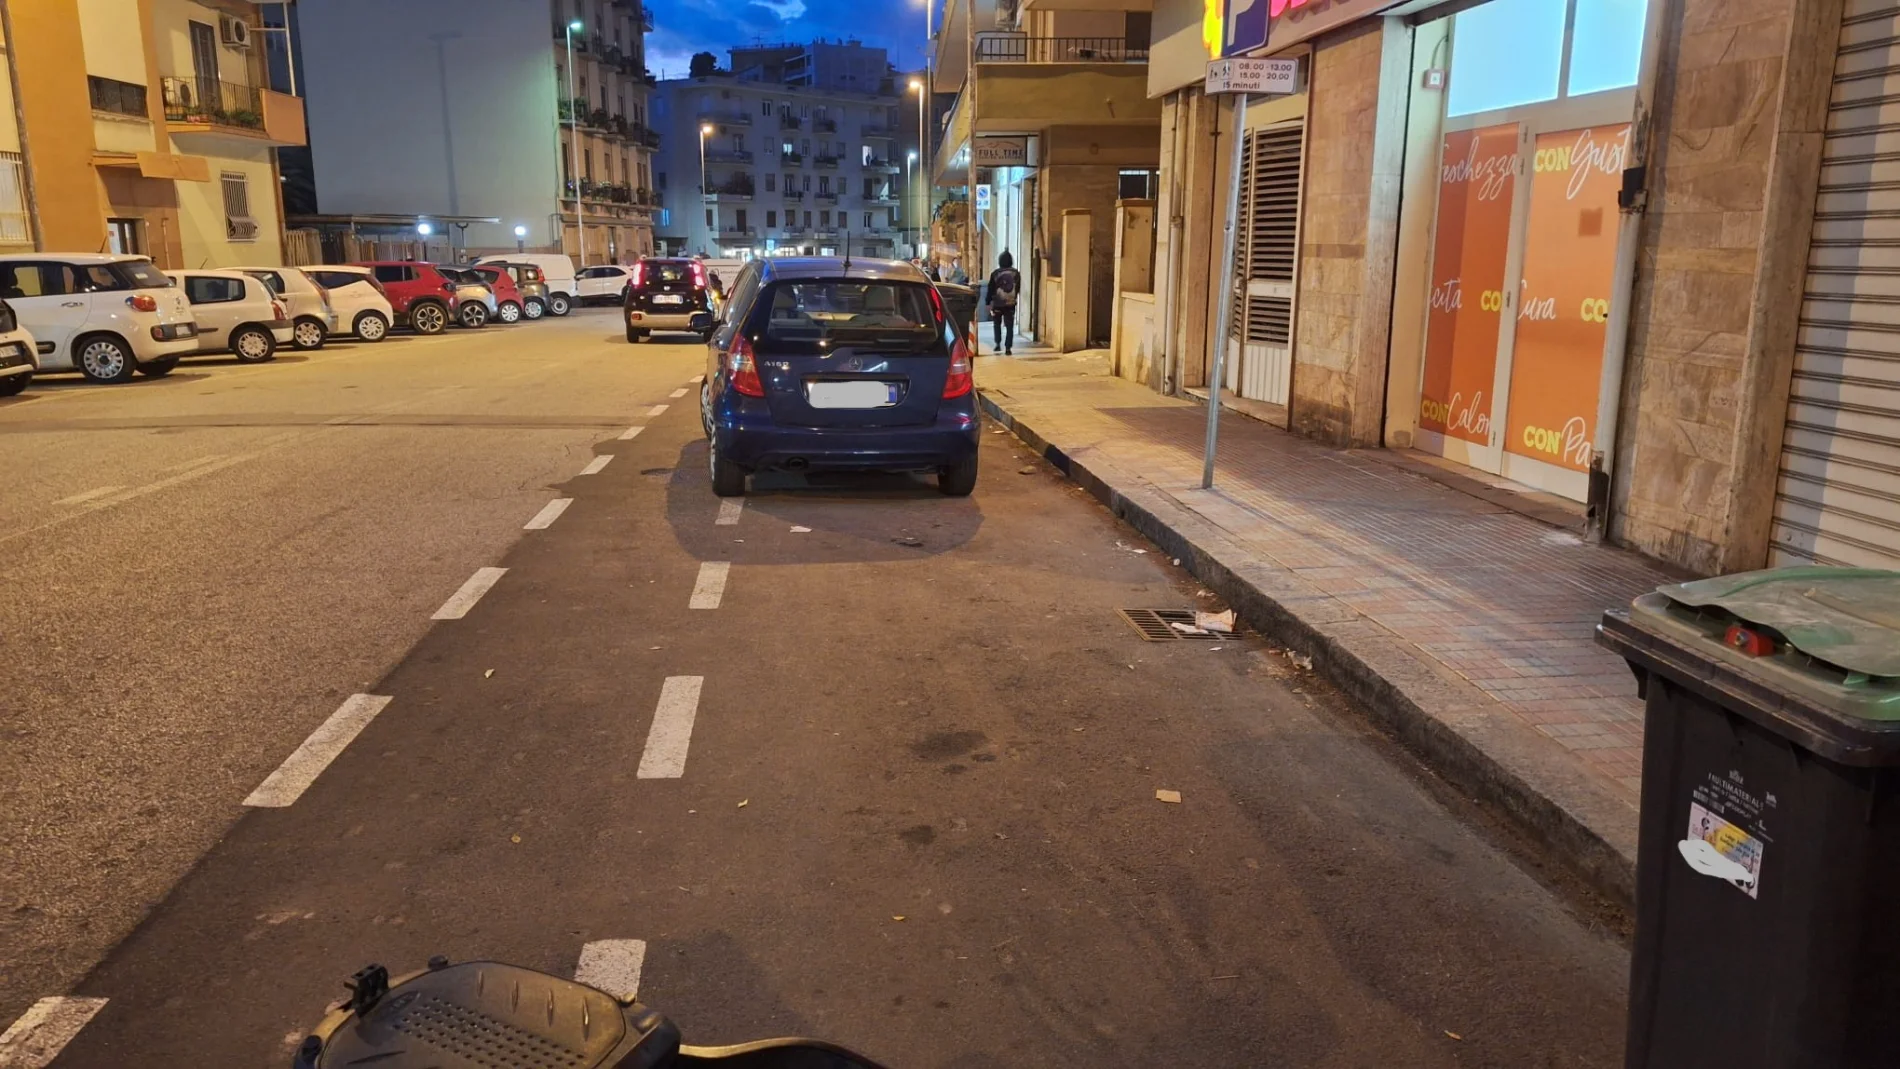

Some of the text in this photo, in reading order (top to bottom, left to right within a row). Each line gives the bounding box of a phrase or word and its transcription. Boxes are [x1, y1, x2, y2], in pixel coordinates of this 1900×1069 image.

[1443, 135, 1517, 201] eschezza
[1566, 125, 1632, 200] Gust
[1481, 290, 1502, 311] CO
[1581, 297, 1609, 323] CO
[1523, 416, 1591, 468] CON Pa
